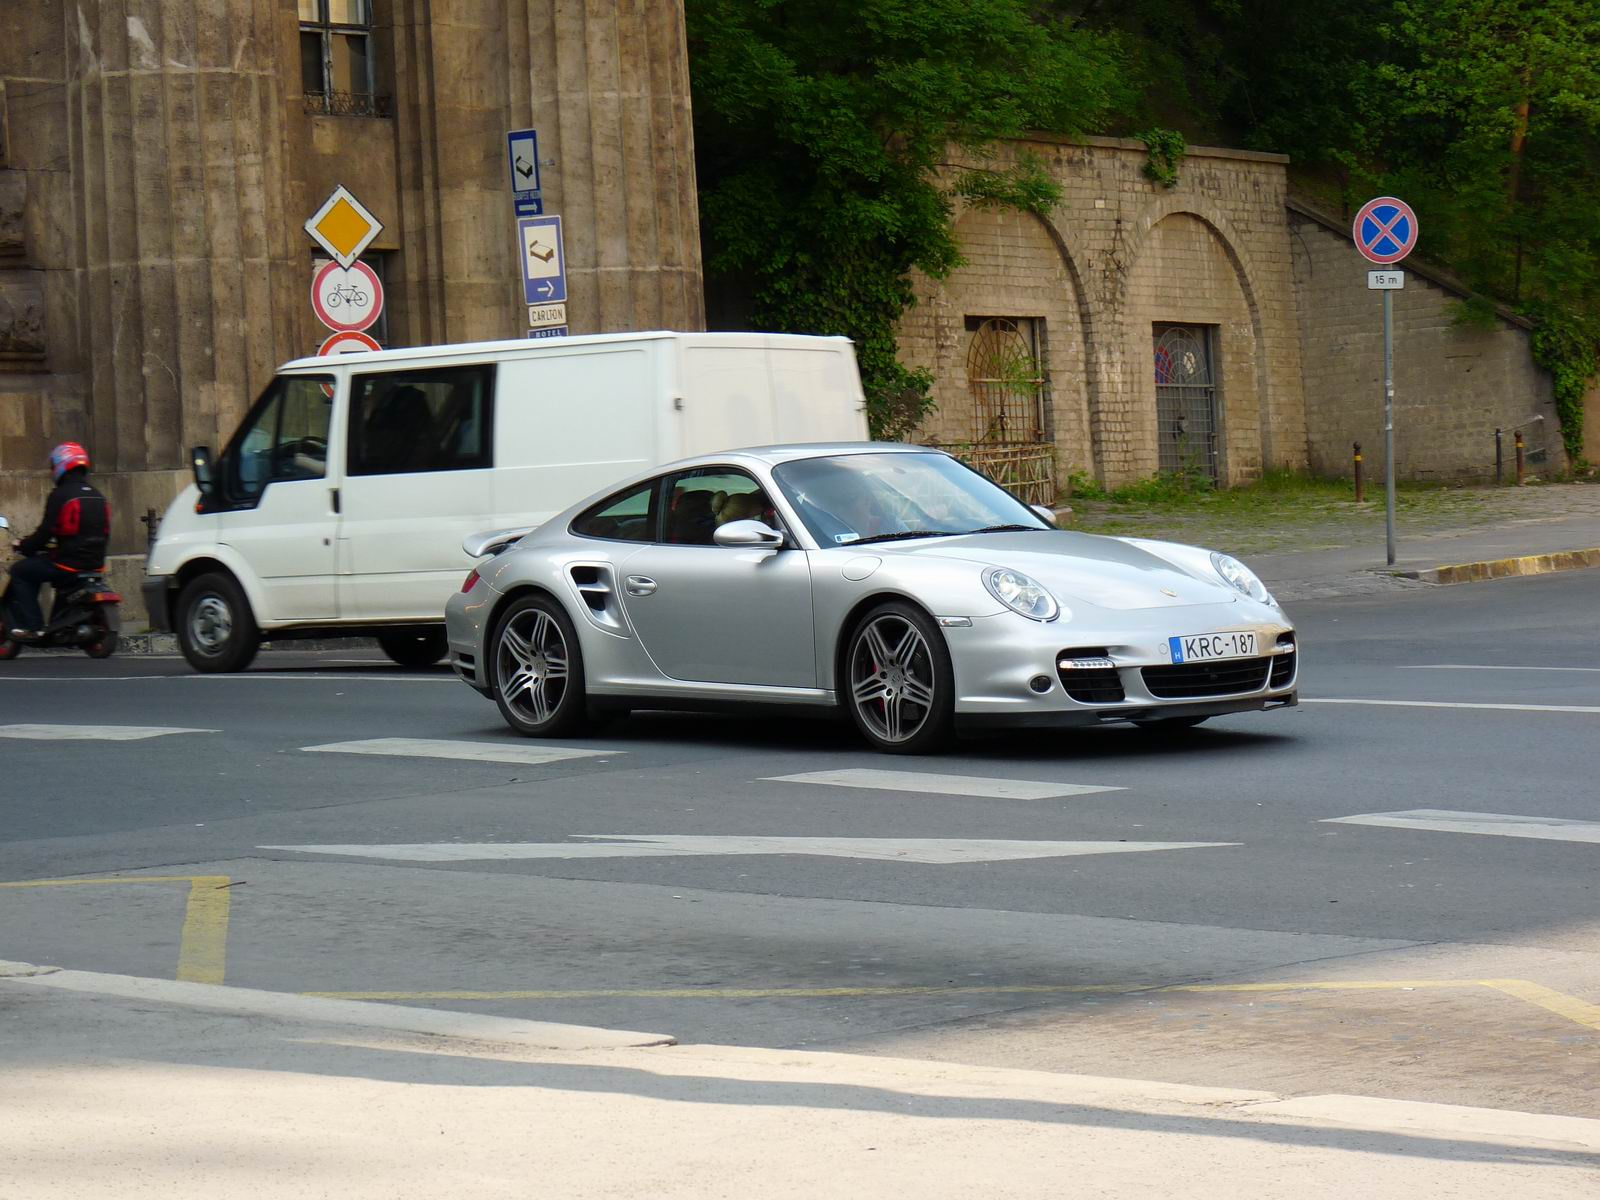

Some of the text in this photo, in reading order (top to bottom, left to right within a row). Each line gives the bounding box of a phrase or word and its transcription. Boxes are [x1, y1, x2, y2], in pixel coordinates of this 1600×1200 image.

[1375, 275, 1385, 285] 15
[531, 309, 563, 322] CARLTON
[1185, 634, 1255, 659] KRC-187
[1175, 651, 1181, 660] H
